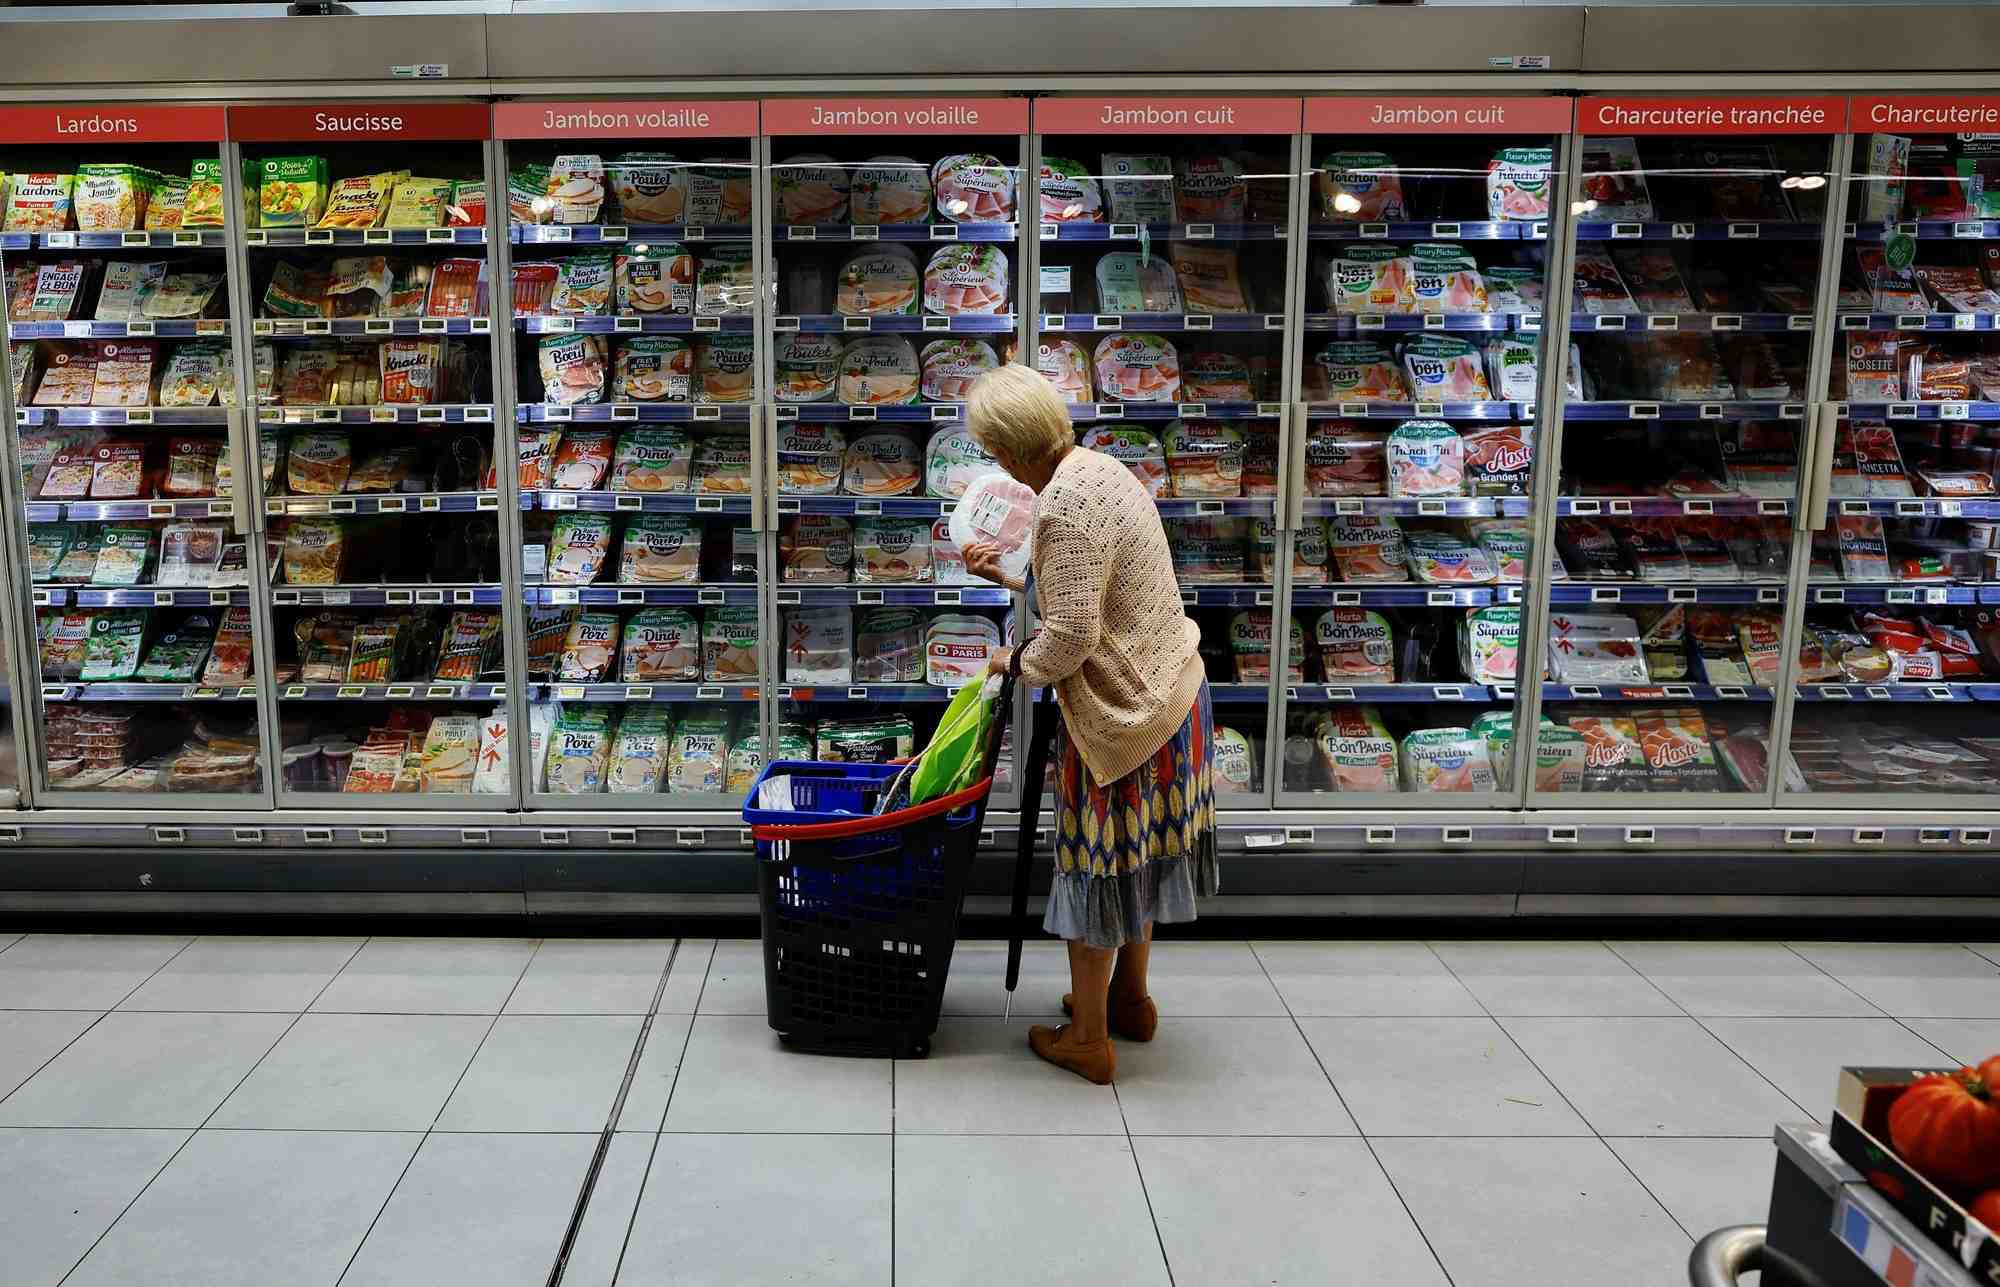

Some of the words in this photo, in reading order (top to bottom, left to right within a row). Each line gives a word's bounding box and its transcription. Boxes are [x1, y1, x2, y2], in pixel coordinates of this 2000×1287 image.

[544, 111, 628, 128] Jambon
[636, 110, 710, 127] volaille
[812, 107, 897, 124] Jambon
[905, 107, 978, 124] volaille
[1101, 106, 1187, 123] Jambon
[1194, 107, 1234, 123] cuit
[1371, 105, 1457, 123] Jambon
[1465, 106, 1504, 123] cuit
[1599, 106, 1723, 124] Charcuterie
[1731, 105, 1824, 124] tranchée
[1871, 105, 1998, 122] Charcuterie
[56, 115, 137, 133] Lardons
[315, 113, 402, 130] Saucisse
[1505, 151, 1528, 161] Fleury
[631, 171, 671, 185] Poulet
[15, 186, 64, 197] Lardons
[1493, 191, 1499, 201] 4
[1414, 248, 1436, 256] Fleury
[1436, 248, 1461, 256] Michon
[940, 273, 985, 285] Supérieur
[784, 345, 832, 359] Poulet
[1115, 353, 1161, 362] Supérieur
[385, 353, 427, 370] Knacki
[1411, 357, 1446, 375] bon
[1849, 360, 1893, 370] ROSETTE
[784, 437, 832, 451] Poulet
[1312, 445, 1346, 456] PARIS
[636, 447, 674, 460] Dinde
[1481, 472, 1518, 481] Grandes
[1512, 482, 1520, 491] 6
[571, 529, 599, 542] Porc
[646, 534, 683, 545] Poulet
[875, 534, 914, 545] Poulet
[1366, 528, 1401, 541] PARIS
[580, 625, 608, 640] Porc
[643, 629, 681, 641] Dinde
[723, 626, 758, 639] Poule
[1320, 623, 1350, 639] Bon
[1350, 623, 1385, 637] PARIS
[952, 650, 983, 658] PARIS
[1474, 650, 1481, 660] 4
[564, 734, 595, 749] Porc
[684, 736, 716, 752] Porc
[1328, 737, 1359, 753] Bon
[1360, 739, 1393, 753] PARIS
[1651, 742, 1698, 767] Aoste
[676, 766, 681, 775] 6
